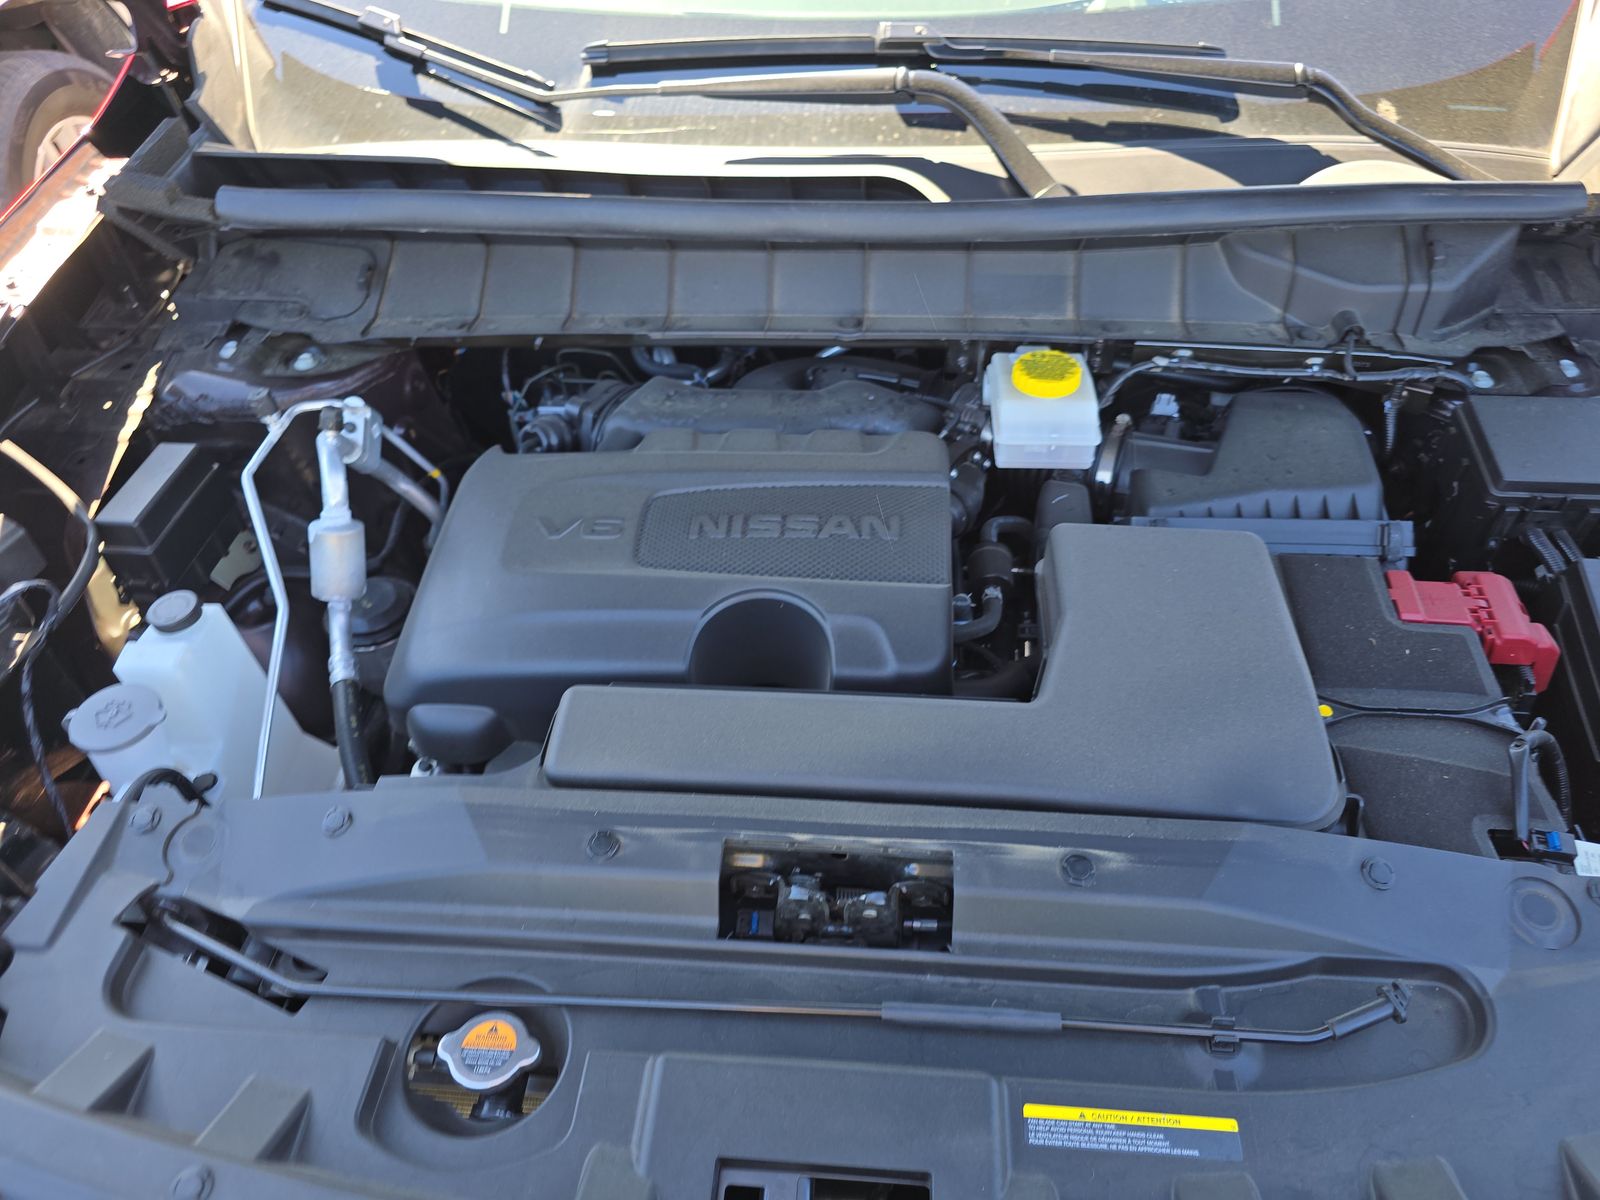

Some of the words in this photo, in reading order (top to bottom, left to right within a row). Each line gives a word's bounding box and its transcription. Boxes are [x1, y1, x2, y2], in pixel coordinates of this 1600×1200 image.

[536, 517, 625, 541] V6
[689, 514, 899, 541] NISSAN
[1091, 1113, 1128, 1122] CAUTION
[1136, 1116, 1180, 1125] ATTENTION
